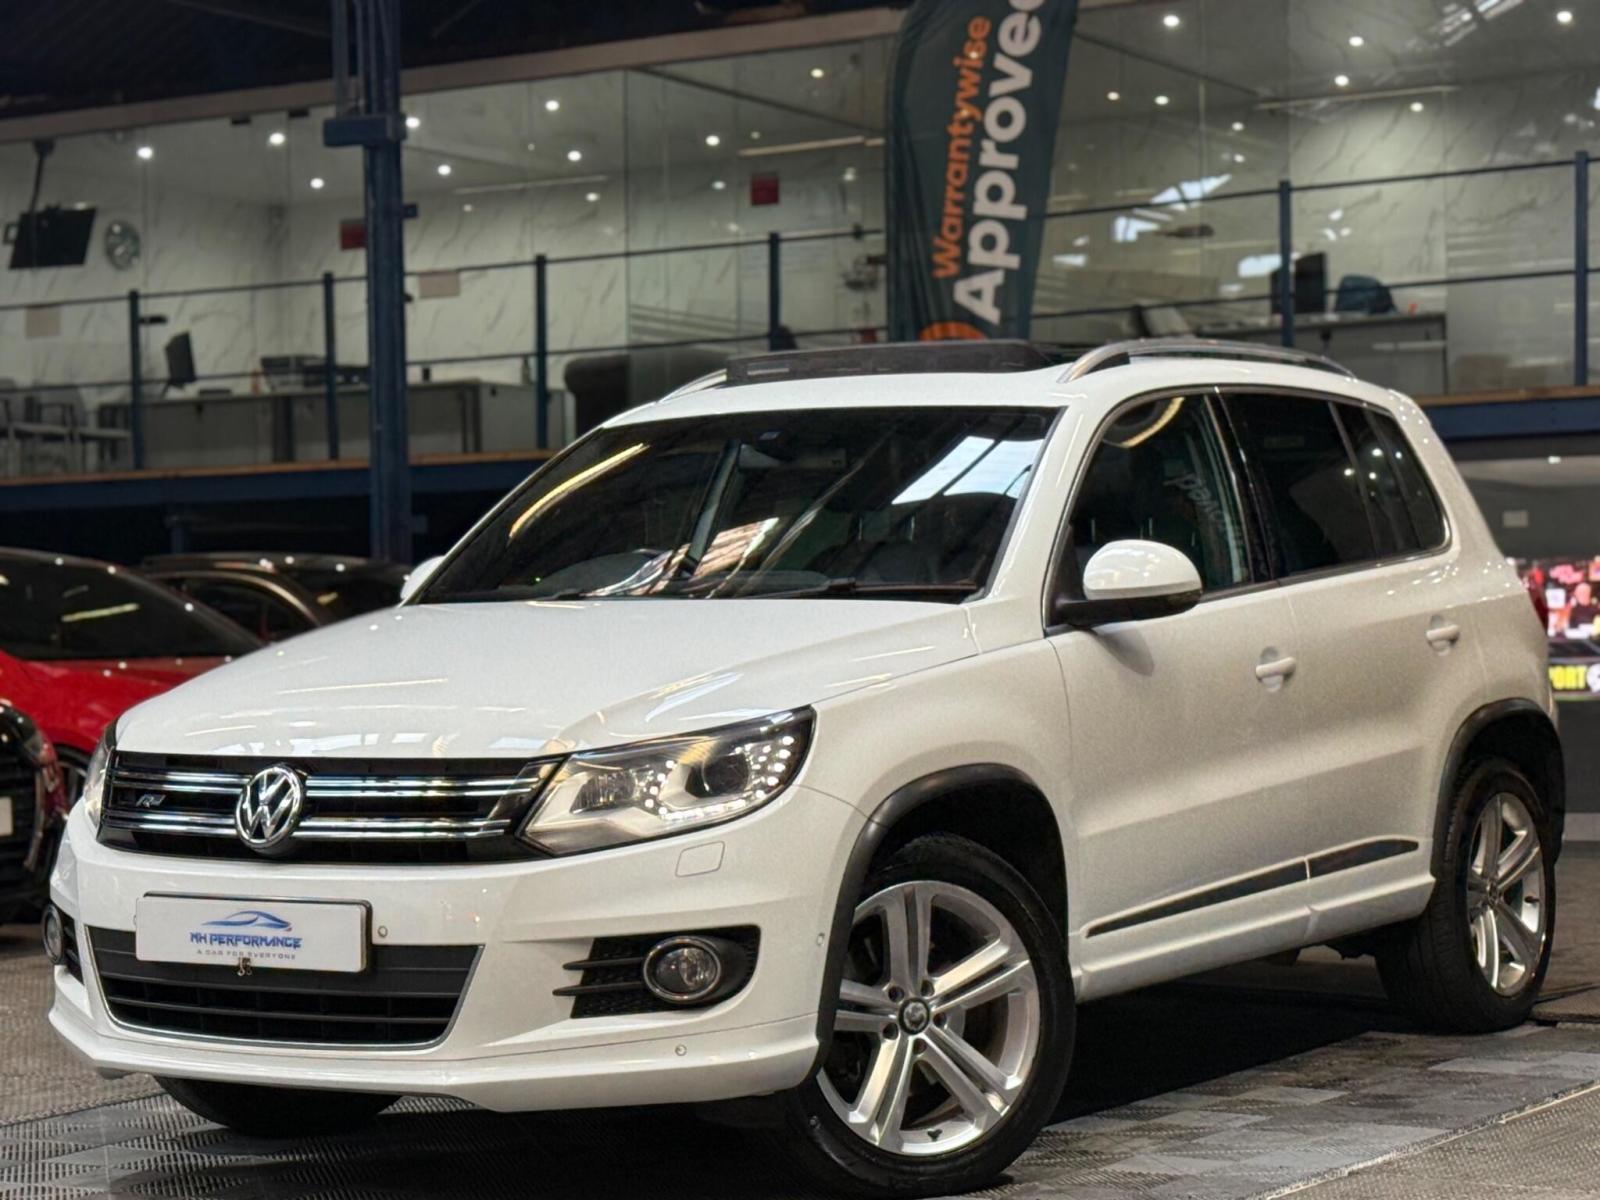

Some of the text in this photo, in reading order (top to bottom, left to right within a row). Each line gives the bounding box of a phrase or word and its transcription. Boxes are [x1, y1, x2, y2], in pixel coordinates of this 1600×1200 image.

[931, 15, 992, 278] Warrantywise
[953, 0, 1043, 325] Approve
[209, 933, 302, 949] PERFORMANCE
[247, 952, 296, 960] EVERYONE
